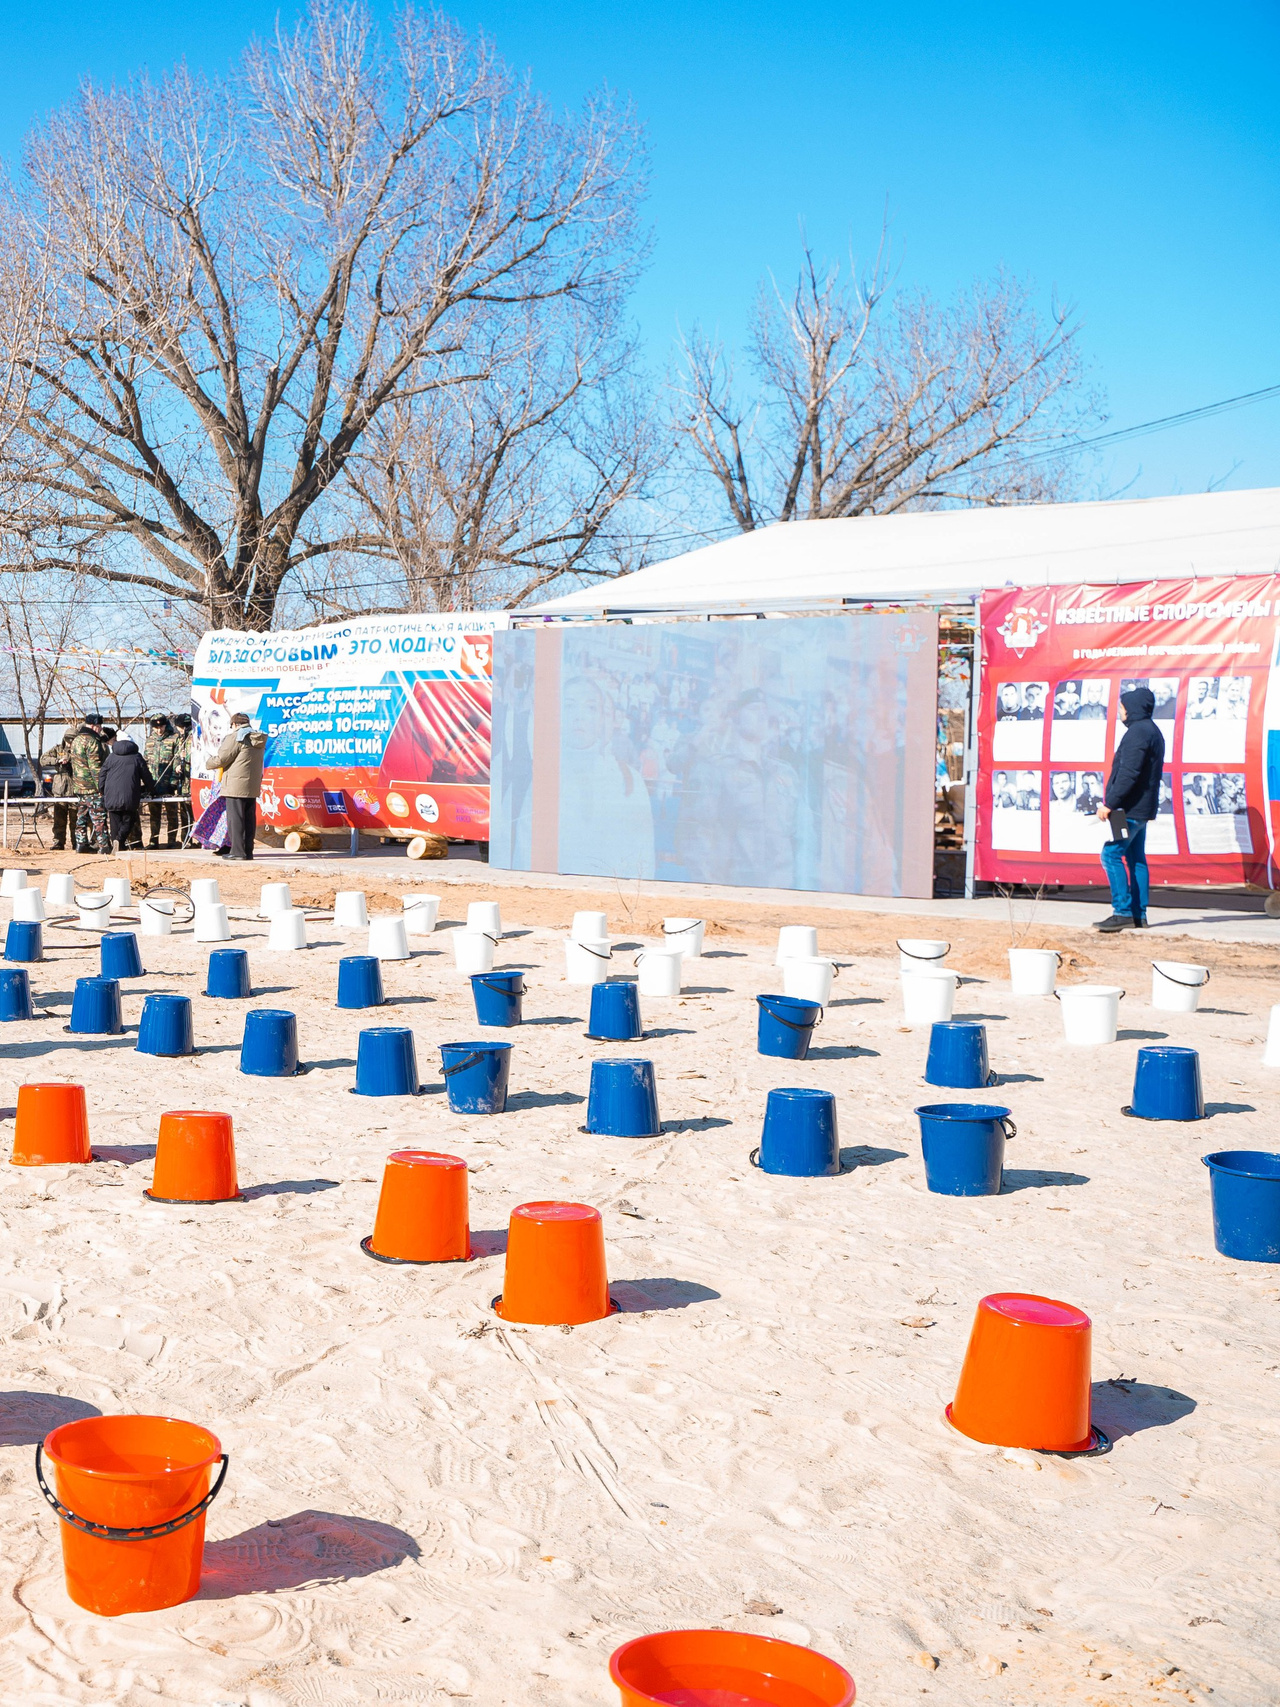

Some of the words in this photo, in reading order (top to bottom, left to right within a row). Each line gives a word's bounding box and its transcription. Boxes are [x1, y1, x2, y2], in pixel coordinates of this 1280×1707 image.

[1055, 604, 1150, 625] ИЗВЕСТНЫЕ
[1152, 600, 1271, 621] СПОРТСМЕНЫ
[348, 638, 382, 655] ЭТО
[384, 636, 456, 654] МОДНО
[276, 664, 315, 672] ПОБЕДЫ
[326, 689, 392, 701] ОБЛИВАНИЕ
[338, 701, 376, 715] ВОДОЙ
[335, 717, 352, 732] 10
[352, 720, 390, 732] СТРАН
[305, 734, 383, 754] ВОЛЖСКИЙ
